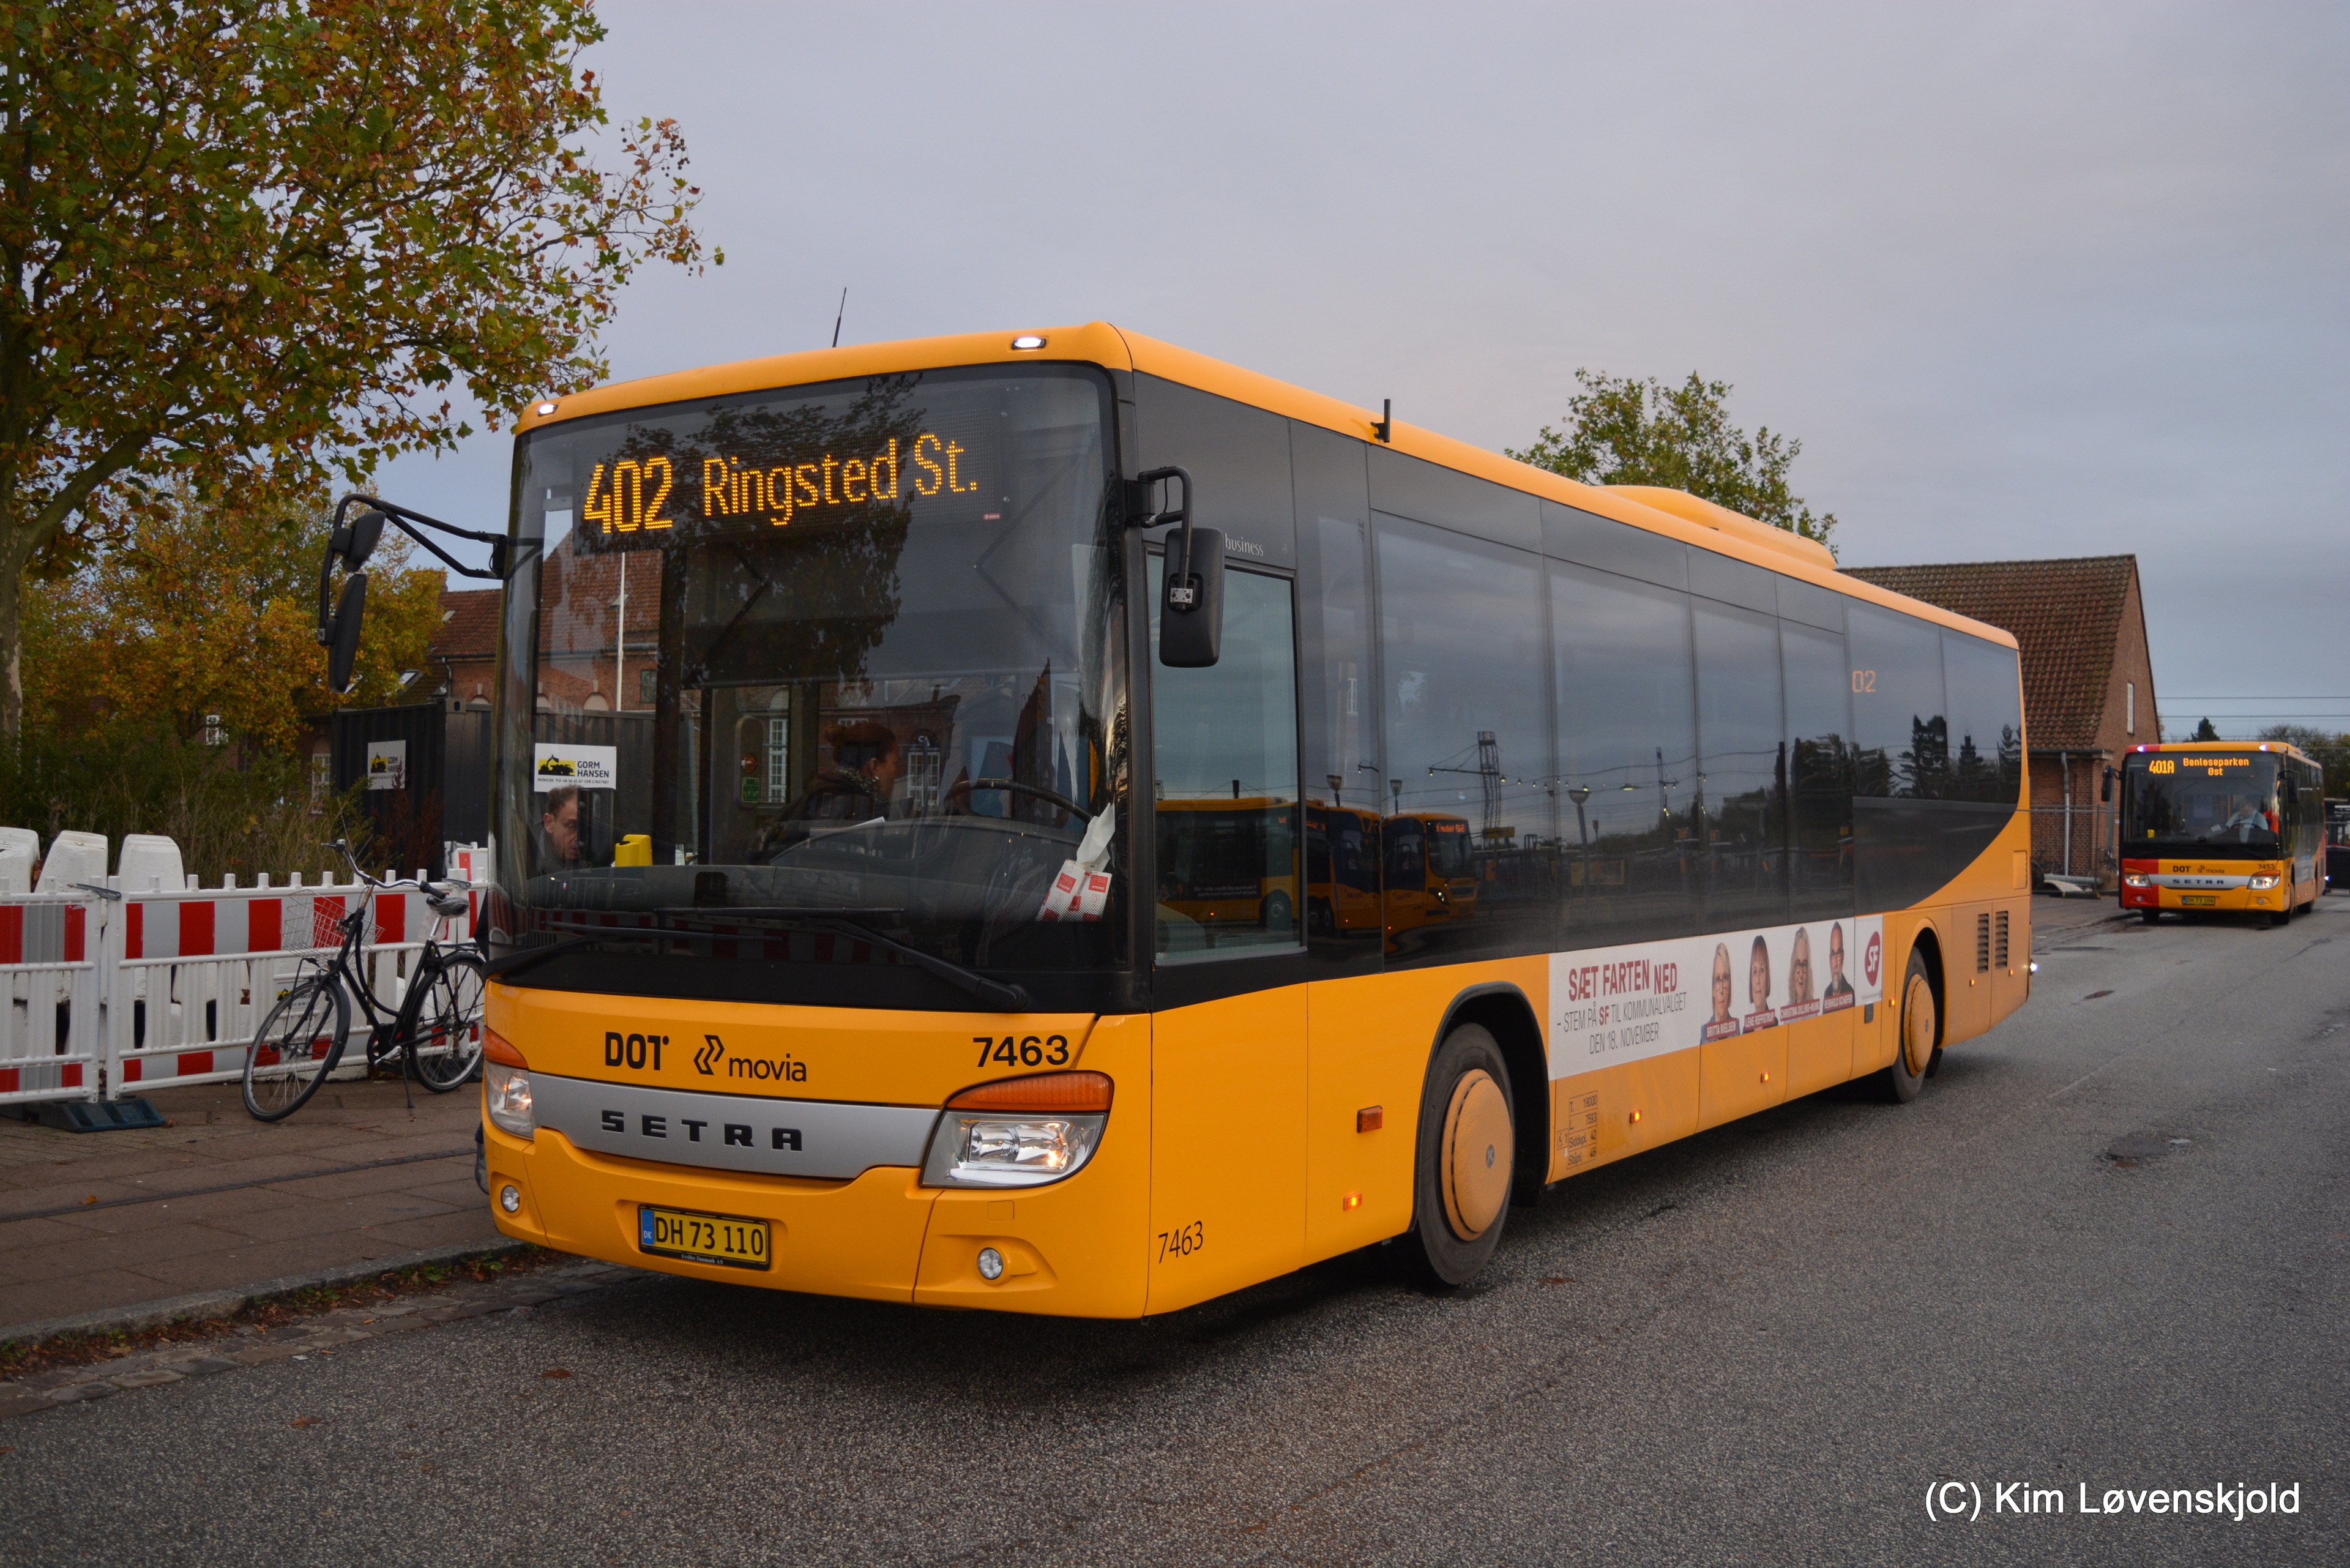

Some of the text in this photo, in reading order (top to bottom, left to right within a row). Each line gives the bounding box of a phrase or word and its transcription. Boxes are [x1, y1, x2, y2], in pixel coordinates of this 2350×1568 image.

[583, 434, 977, 534] 402 Ringsted St.
[1225, 533, 1264, 556] business
[577, 769, 610, 778] HANSEN
[2149, 760, 2174, 774] 401A
[1867, 945, 1879, 973] SF
[1569, 959, 1677, 1002] SÆT FARTEN NED
[1564, 1010, 1585, 1032] STEM
[1587, 1001, 1597, 1028] PÅ
[1599, 1006, 1609, 1026] SF
[1611, 1004, 1621, 1023] TIL
[1623, 992, 1687, 1021] KOMMUNALVALGET
[1590, 1022, 1659, 1055] DEN 18. NOVEMBER
[1706, 1021, 1736, 1037] BRITTA NIELSEN
[605, 1031, 807, 1082] DOT movia
[973, 1034, 1069, 1067] 7463
[601, 1110, 802, 1151] SETRA
[643, 1230, 652, 1239] DK
[655, 1217, 764, 1256] DH 73 110
[1158, 1220, 1204, 1264] 7463
